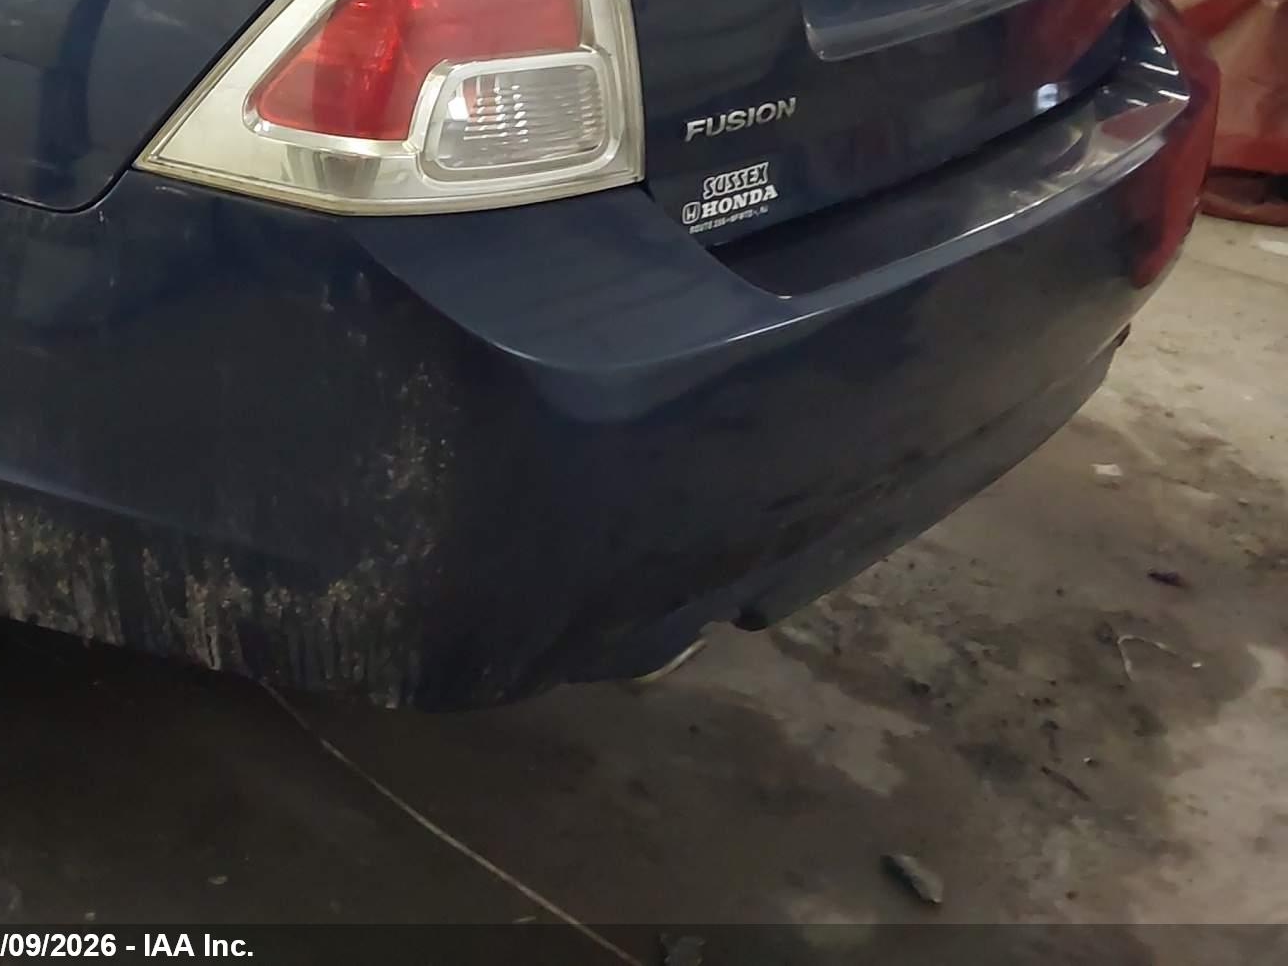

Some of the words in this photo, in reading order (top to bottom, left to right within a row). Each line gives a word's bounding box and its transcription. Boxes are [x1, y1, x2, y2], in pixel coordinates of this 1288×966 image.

[685, 97, 797, 142] FUSION
[703, 162, 769, 200] SUSSEX
[701, 185, 778, 219] HONDA
